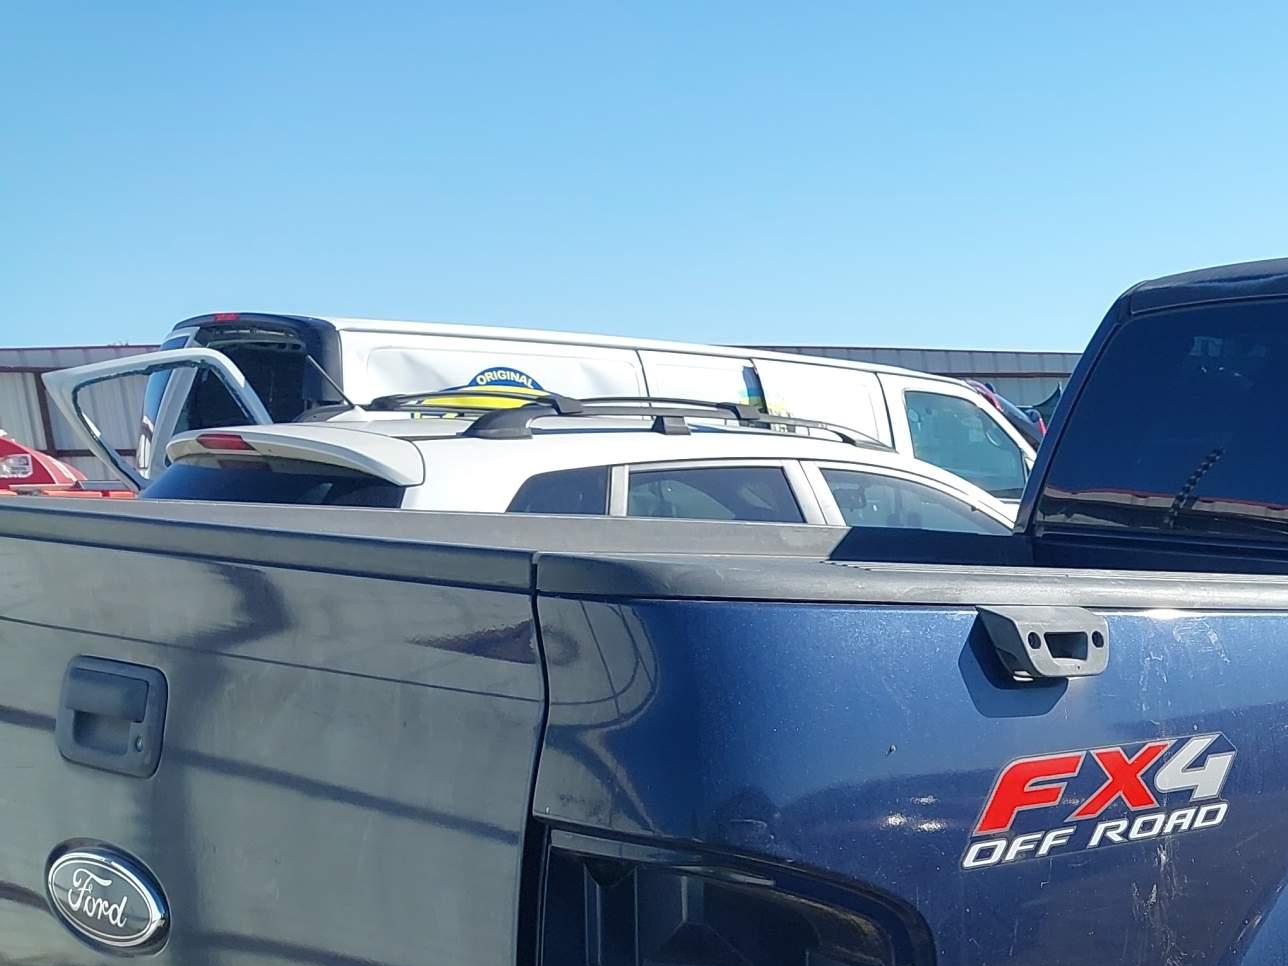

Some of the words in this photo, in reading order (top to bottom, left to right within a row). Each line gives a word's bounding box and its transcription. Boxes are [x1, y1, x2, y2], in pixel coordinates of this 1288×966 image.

[476, 370, 534, 389] ORIGINAL
[972, 734, 1234, 836] FX4
[961, 825, 1077, 869] OFF
[1086, 803, 1229, 849] ROAD
[67, 867, 127, 928] Ford
